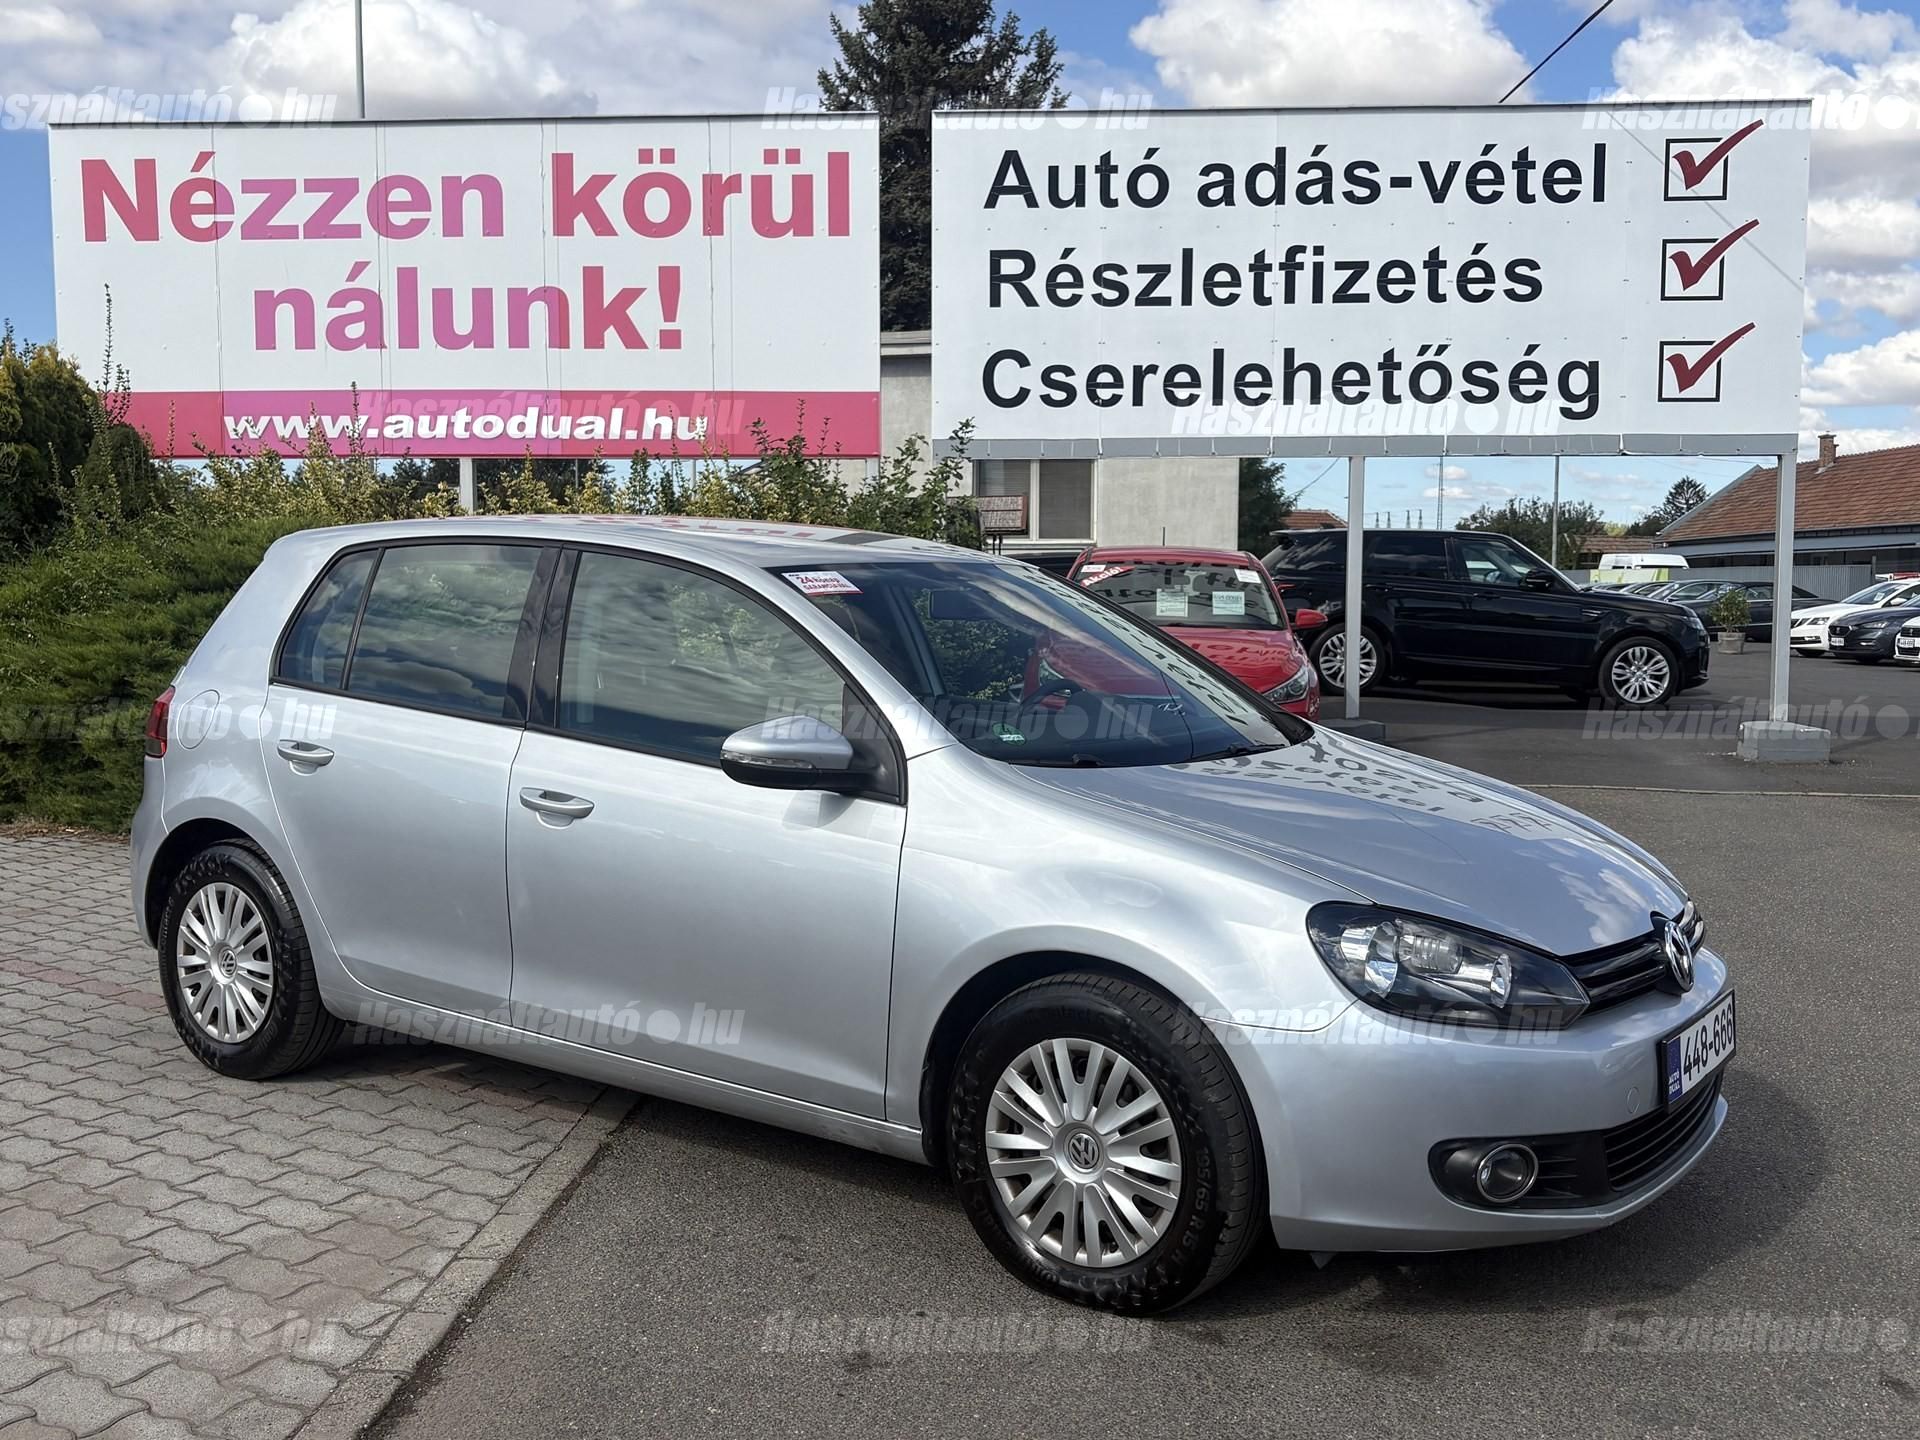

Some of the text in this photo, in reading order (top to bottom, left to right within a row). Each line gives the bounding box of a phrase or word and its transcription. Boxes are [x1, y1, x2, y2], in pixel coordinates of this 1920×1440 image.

[82, 148, 851, 242] Nézzen körül
[983, 142, 1607, 209] Autó adás-vétel
[254, 261, 683, 350] nálunk!
[988, 242, 1544, 308] Részletfizetés
[981, 343, 1601, 421] Cserelehetőség
[223, 406, 709, 440] www.autodual.hu
[1083, 566, 1124, 587] Akció!
[1683, 1002, 1733, 1081] 448-666
